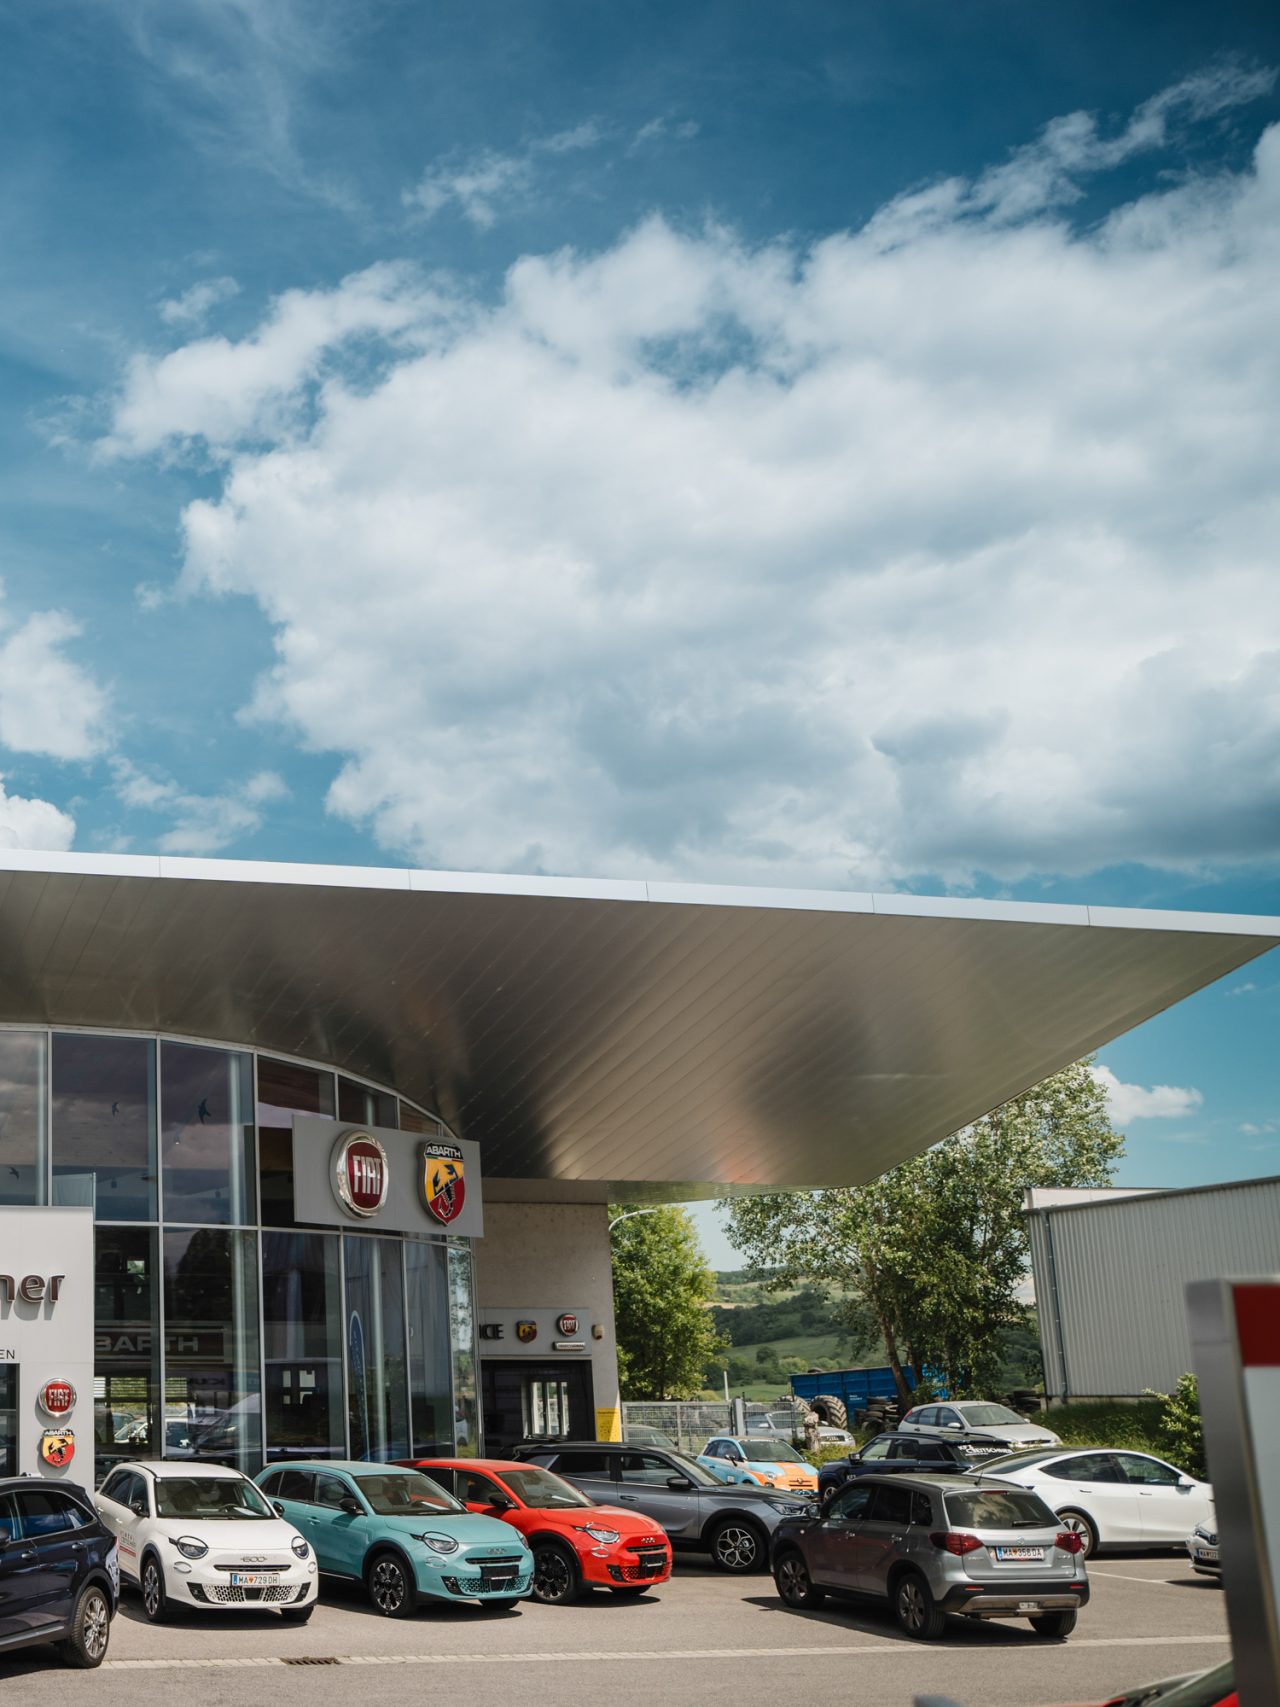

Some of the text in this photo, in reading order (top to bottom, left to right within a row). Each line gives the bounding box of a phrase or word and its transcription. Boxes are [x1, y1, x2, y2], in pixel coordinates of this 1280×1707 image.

[426, 1145, 462, 1159] ABARTH
[352, 1155, 382, 1195] FIAT
[47, 1388, 70, 1407] FIAT
[238, 1576, 249, 1584] MA
